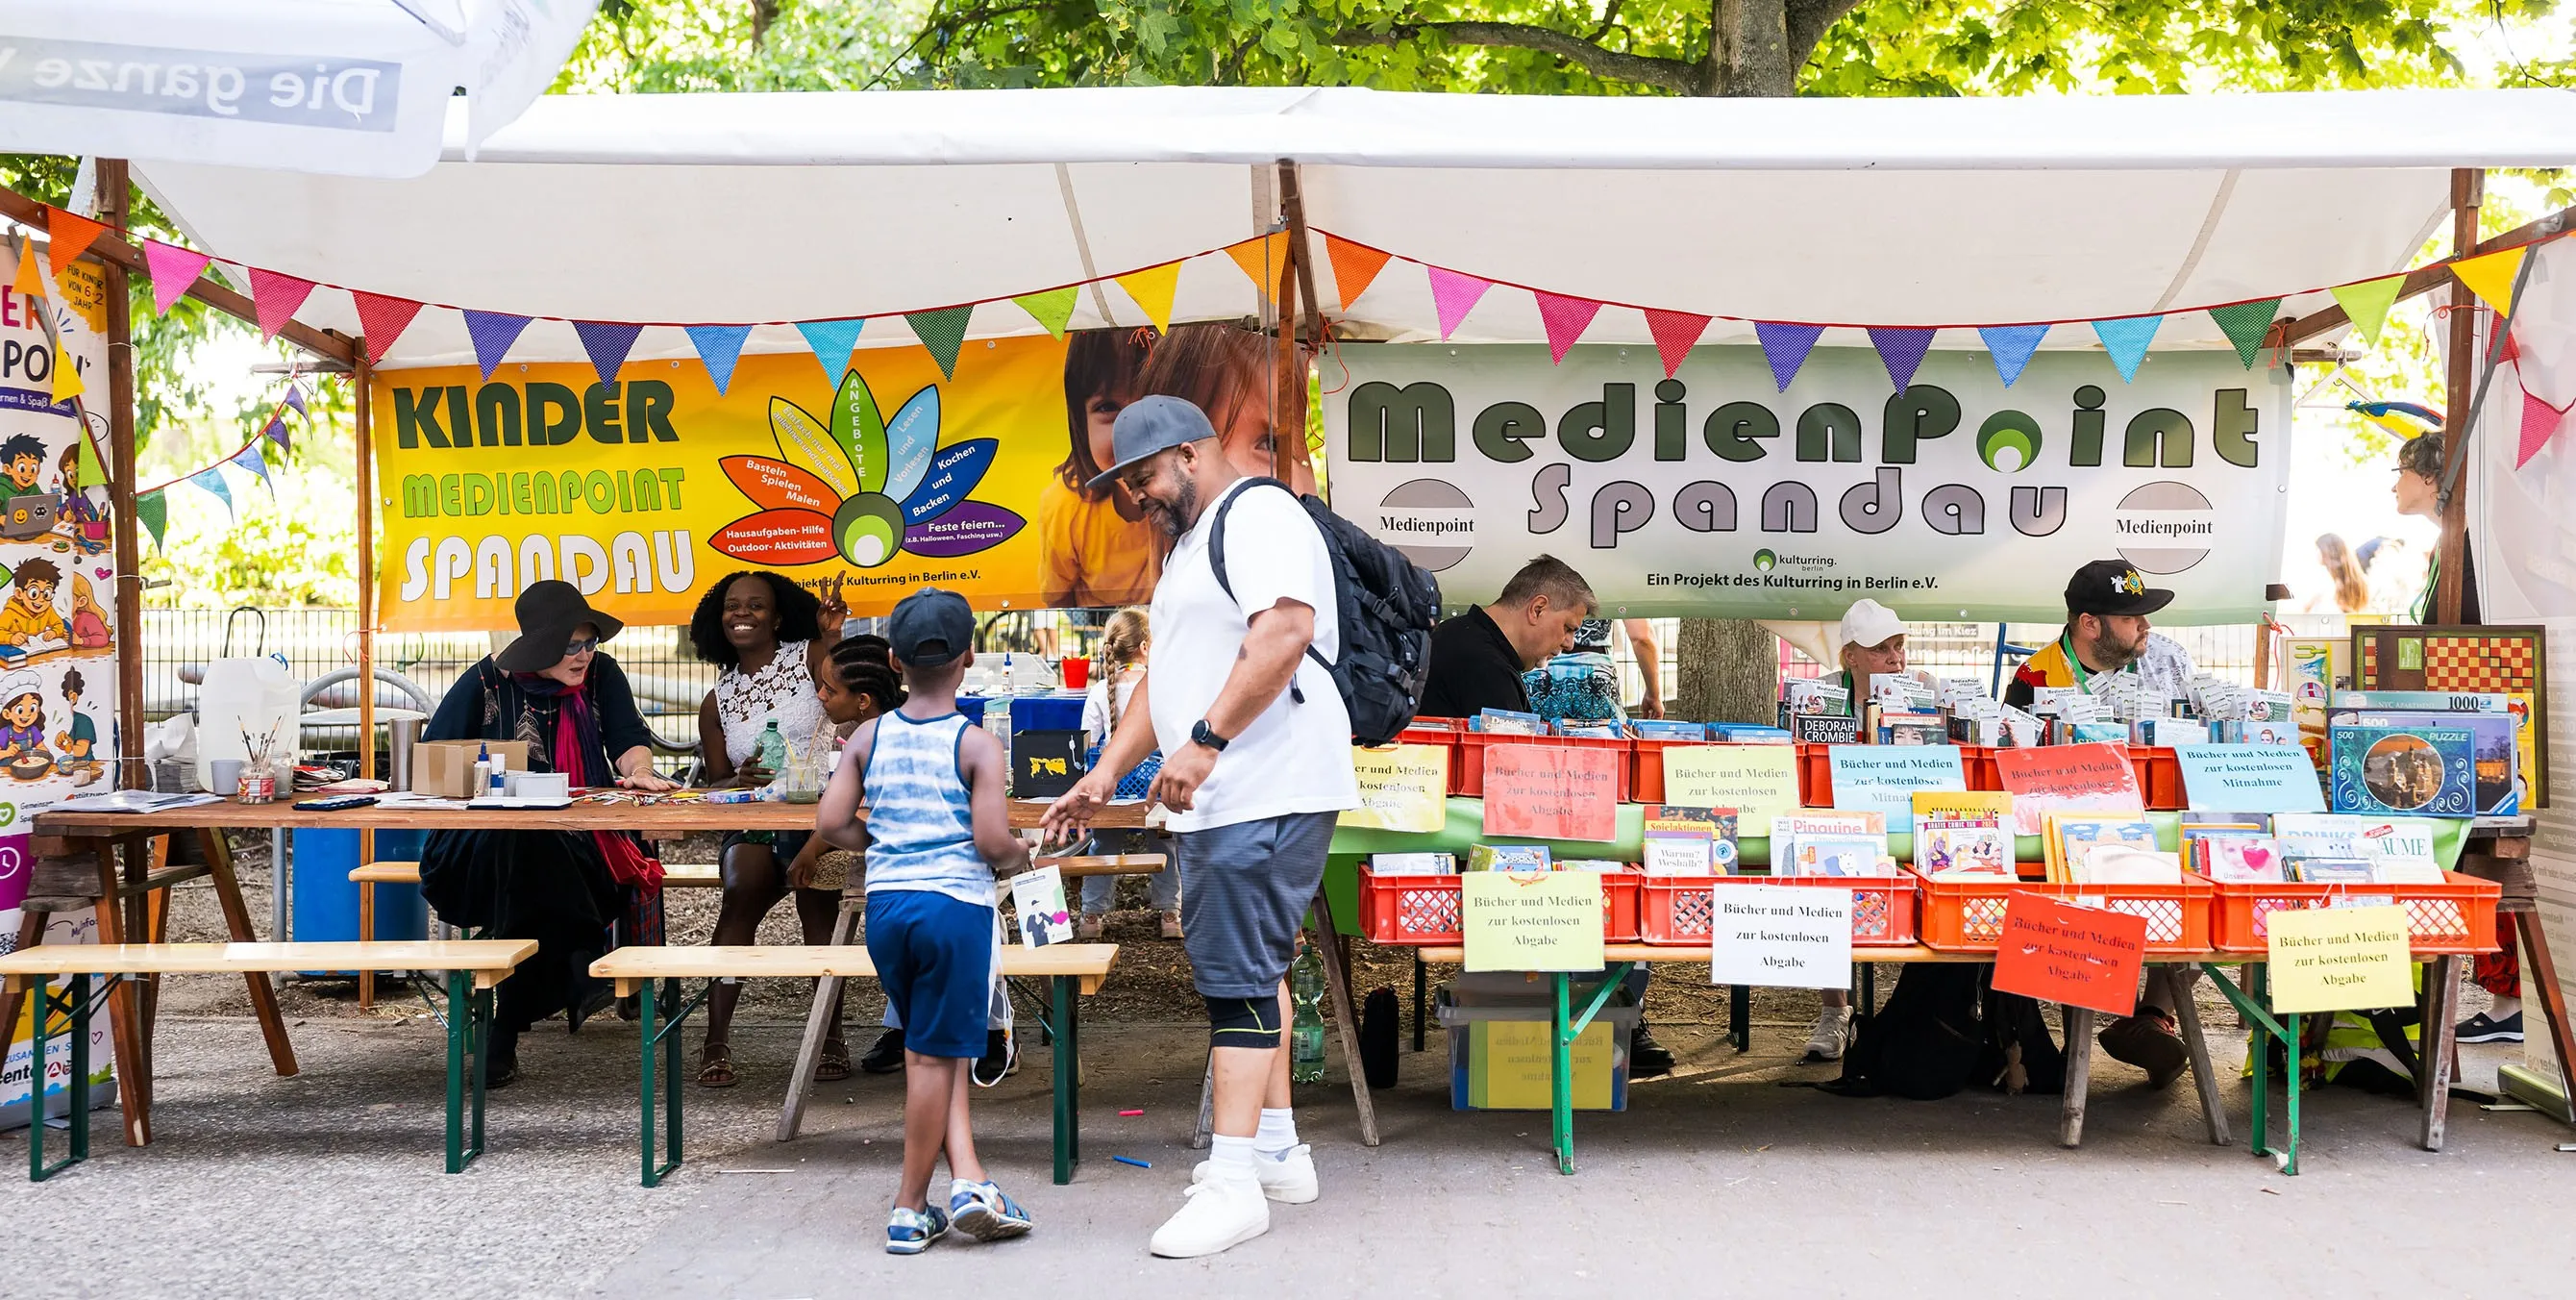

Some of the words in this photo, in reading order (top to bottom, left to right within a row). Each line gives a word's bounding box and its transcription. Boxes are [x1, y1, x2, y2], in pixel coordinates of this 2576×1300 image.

[67, 279, 82, 293] VON
[27, 395, 48, 409] Spaß
[392, 380, 681, 449] KINDER
[897, 404, 924, 433] Lesen
[781, 405, 813, 440] Einfach
[811, 438, 828, 455] nur
[827, 453, 845, 472] mal
[897, 435, 916, 457] und
[772, 411, 804, 447] anlehnen
[802, 443, 818, 461] und
[814, 458, 849, 497] quatschen
[937, 444, 976, 471] Kochen
[746, 459, 787, 478] Basteln
[893, 445, 929, 484] Vorlesen
[760, 474, 802, 492] Spielen
[931, 472, 954, 490] und
[403, 467, 684, 517] MEDIENPOINT
[785, 490, 821, 507] Malen
[912, 492, 951, 517] Backen
[1527, 462, 2068, 549] Spandau
[726, 527, 800, 539] Hausaufgaben-
[801, 524, 825, 535] Hilfe
[928, 523, 959, 533] Feste
[1379, 514, 1475, 537] Medienpoint
[2115, 518, 2214, 538] Medienpoint
[956, 533, 985, 541] Fasching
[728, 543, 773, 553] Outdoor-
[774, 540, 828, 551] Aktivitäten
[400, 530, 696, 602] SPANDAU
[846, 574, 906, 588] Kulturring
[908, 572, 920, 584] in
[922, 570, 957, 583] Berlin
[959, 569, 981, 581] e.V.
[1647, 573, 1671, 586] Ein
[1673, 573, 1730, 588] Projekt
[1733, 574, 1760, 587] des
[1763, 574, 1843, 592] Kulturring
[1846, 576, 1862, 588] in
[1865, 576, 1909, 589] Berlin
[1912, 577, 1940, 589] e.V.
[2448, 695, 2480, 710] 1000
[1805, 720, 1855, 732] DEBORAH
[1804, 731, 1855, 743] CROMBIE
[2337, 731, 2355, 739] 500
[2429, 732, 2469, 742] PUZZLE
[2187, 749, 2228, 760] Bücher
[2231, 749, 2254, 760] und
[2257, 749, 2301, 759] Medien
[1370, 765, 1393, 775] und
[1395, 765, 1438, 776] Medien
[1840, 758, 1881, 769] Bücher
[1884, 758, 1907, 769] und
[1910, 758, 1954, 769] Medien
[2011, 766, 2051, 780] Bücher
[2054, 764, 2078, 776] und
[2081, 760, 2124, 773] Medien
[2204, 763, 2223, 773] zur
[2226, 762, 2293, 773] kostenlosen
[1495, 765, 1536, 778] Bücher
[1539, 766, 1563, 779] und
[1567, 769, 1608, 782] Medien
[1675, 768, 1718, 779] Bücher
[1720, 768, 1743, 779] und
[1746, 768, 1788, 779] Medien
[1854, 776, 1874, 787] zur
[1876, 775, 1944, 787] kostenlosen
[1358, 780, 1425, 793] kostenlosen
[2222, 777, 2283, 788] Mitnahme
[1505, 787, 1525, 796] zur
[1528, 786, 1596, 799] kostenlosen
[1689, 787, 1707, 797] zur
[1711, 785, 1777, 796] kostenlosen
[1530, 805, 1573, 817] Abgabe
[1650, 822, 1712, 832] Spielaktionen
[1660, 849, 1700, 859] Warum?
[1658, 858, 1703, 869] Weshalb?
[1474, 896, 1518, 908] Bücher
[1521, 896, 1544, 907] und
[1547, 896, 1592, 907] Medien
[1723, 902, 1768, 915] Bücher
[1771, 905, 1794, 916] und
[1797, 906, 1843, 918] Medien
[1488, 917, 1508, 927] zur
[1511, 915, 1580, 926] kostenlosen
[1512, 935, 1558, 947] Abgabe
[1736, 931, 1757, 941] zur
[1760, 930, 1829, 943] kostenlosen
[2014, 916, 2059, 936] Bücher
[2062, 927, 2086, 941] und
[2090, 931, 2136, 951] Medien
[2279, 934, 2324, 948] Bücher
[2327, 933, 2351, 944] und
[2354, 931, 2400, 943] Medien
[2021, 941, 2043, 953] zur
[2047, 942, 2119, 968] kostenlosen
[2294, 956, 2316, 967] zur
[2318, 952, 2389, 966] kostenlosen
[1759, 956, 1805, 969] Abgabe
[2046, 964, 2092, 983] Abgabe
[2319, 973, 2367, 987] Abgabe
